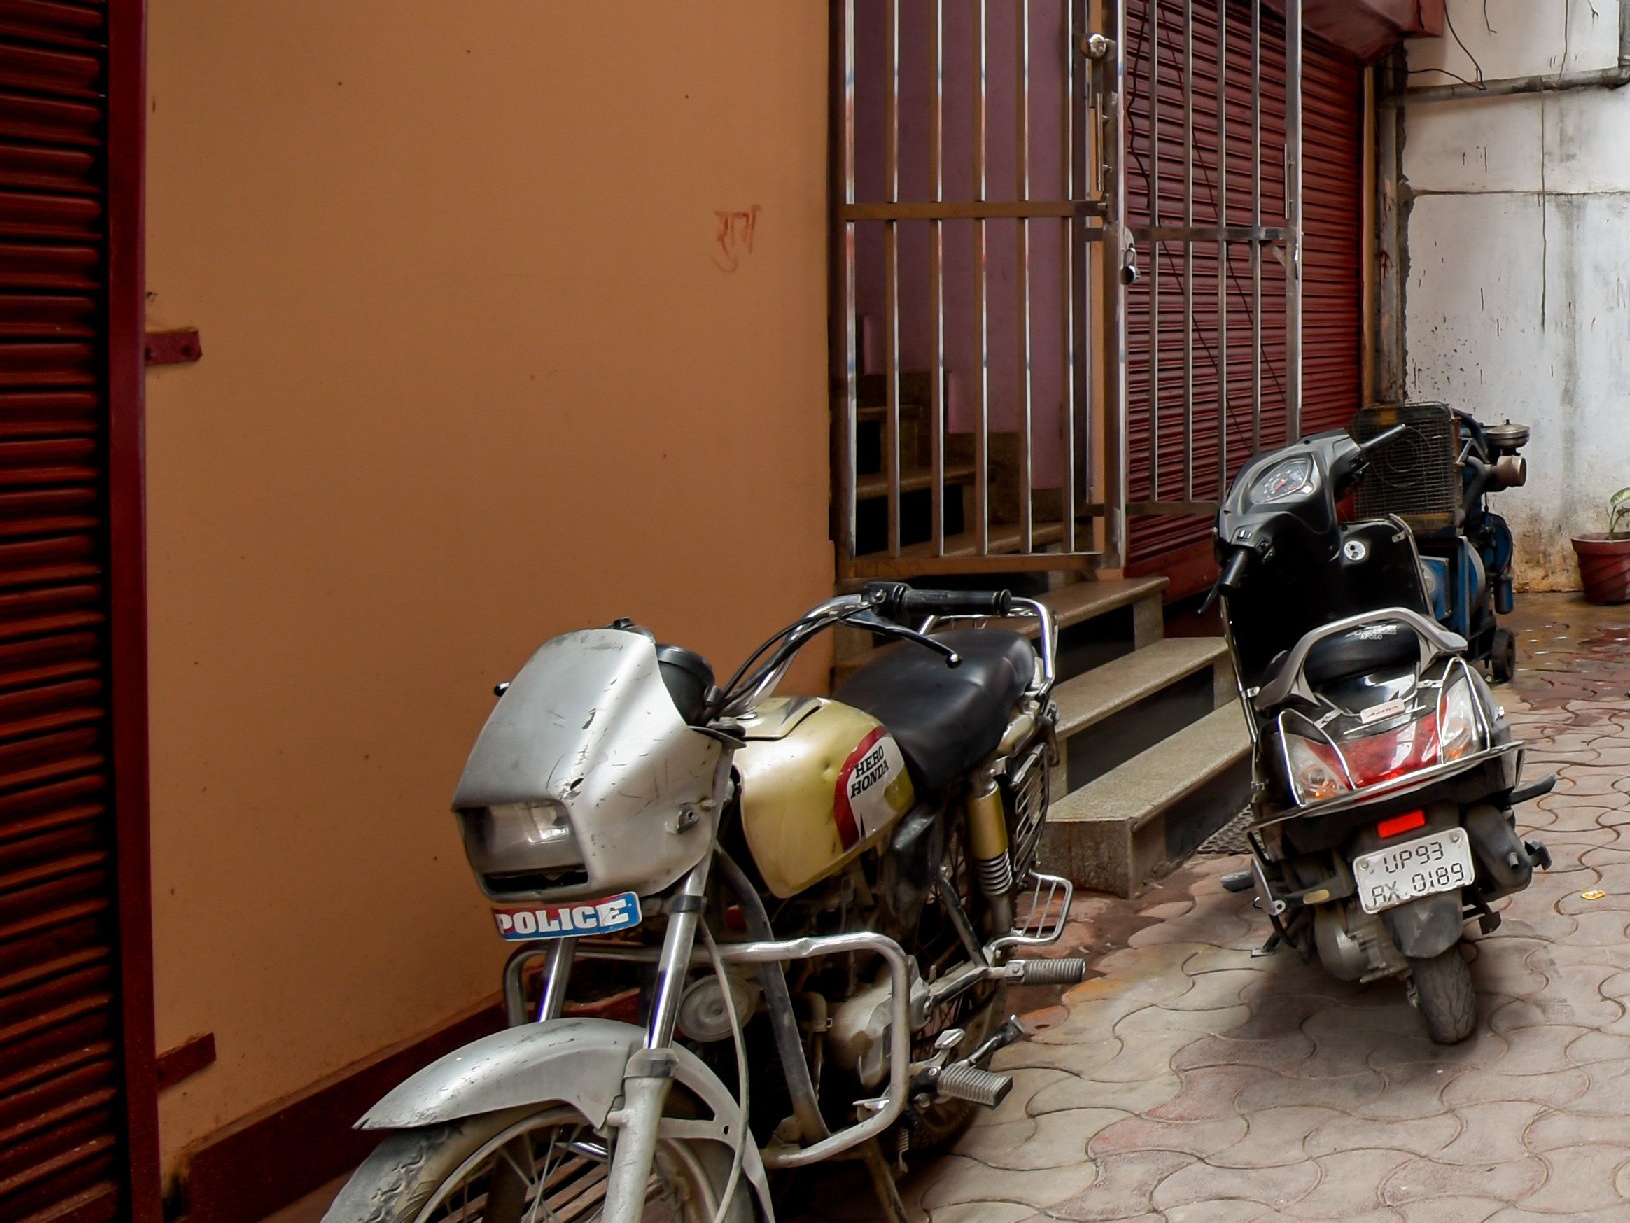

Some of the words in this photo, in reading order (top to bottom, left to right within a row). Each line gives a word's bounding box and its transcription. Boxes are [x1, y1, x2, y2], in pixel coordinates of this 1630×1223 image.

[850, 759, 890, 799] HONDA
[855, 744, 885, 779] HERO
[1383, 841, 1444, 874] UP93
[1411, 862, 1464, 893] 0189
[495, 898, 629, 935] POLICE
